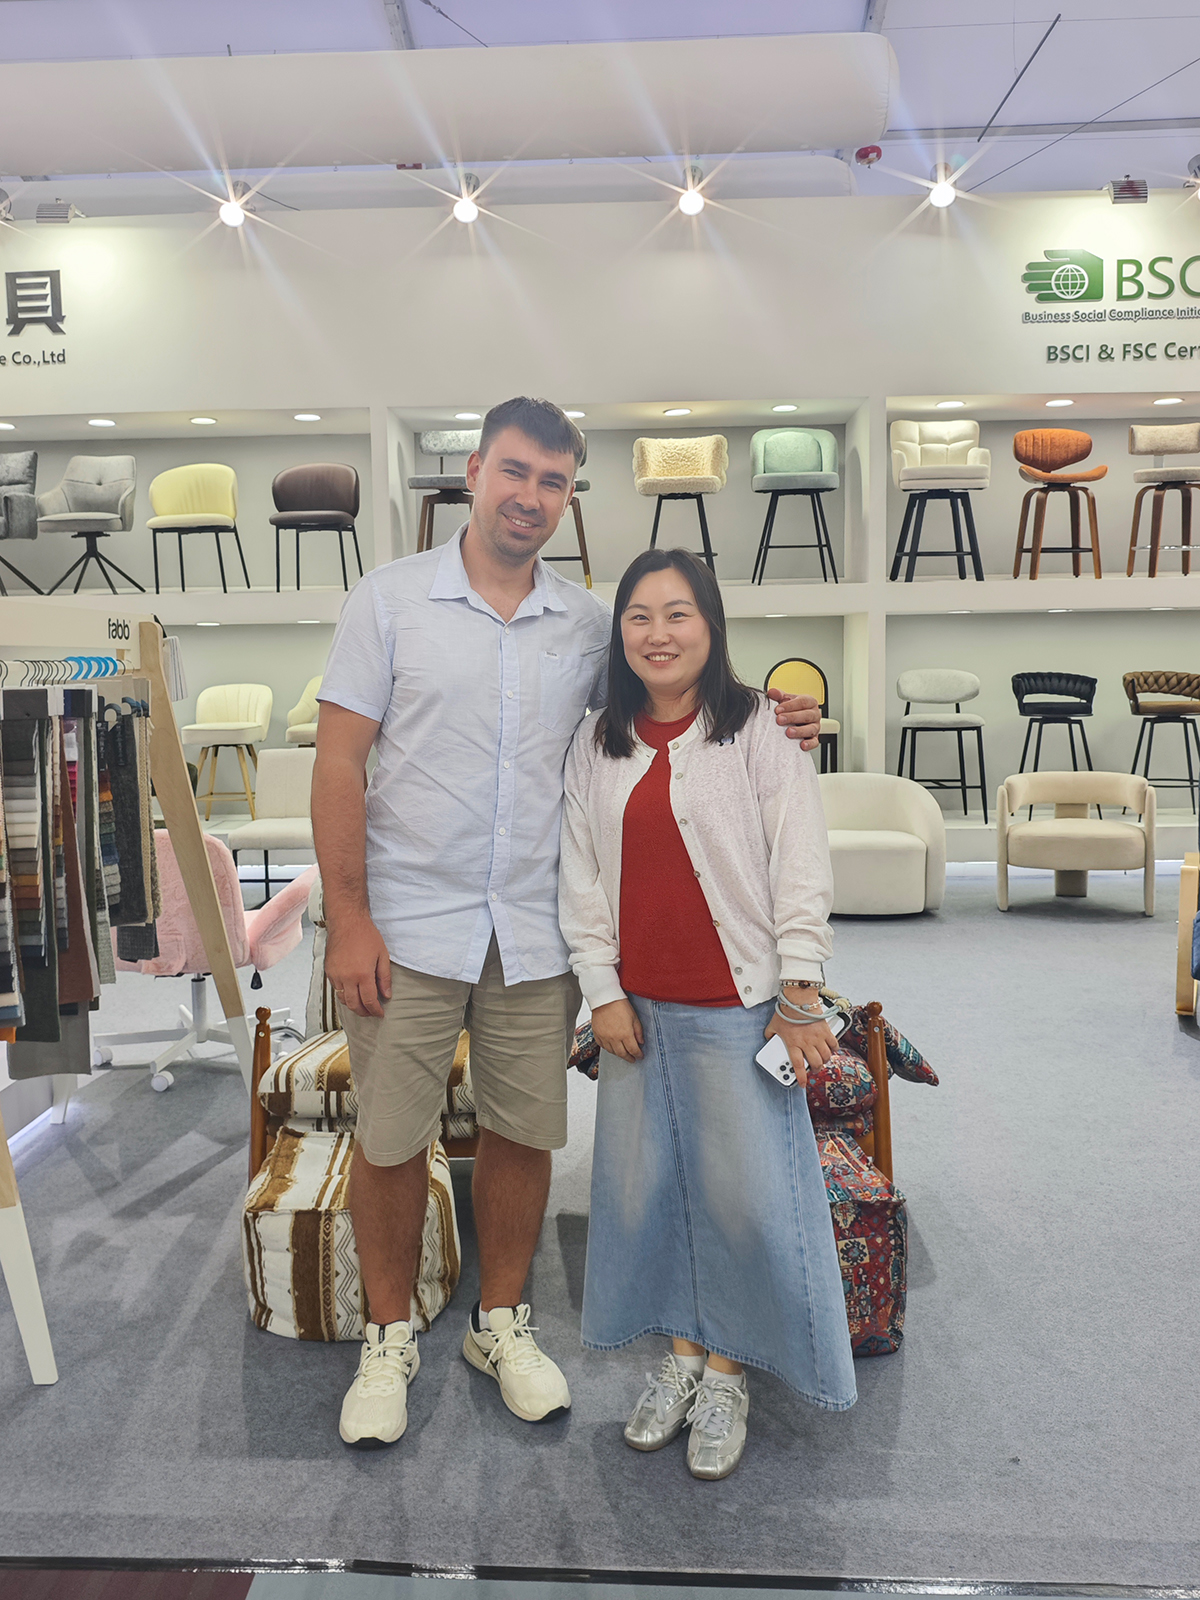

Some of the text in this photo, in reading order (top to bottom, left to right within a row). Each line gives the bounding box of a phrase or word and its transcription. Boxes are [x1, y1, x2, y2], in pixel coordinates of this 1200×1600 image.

[5, 269, 66, 337] 具
[1023, 310, 1071, 322] Business
[1074, 309, 1107, 321] Social
[1109, 307, 1174, 322] Compliance
[12, 348, 66, 367] Co.,Ltd
[1047, 344, 1090, 361] BSCI
[1098, 343, 1115, 360] &
[1122, 342, 1157, 360] FSC
